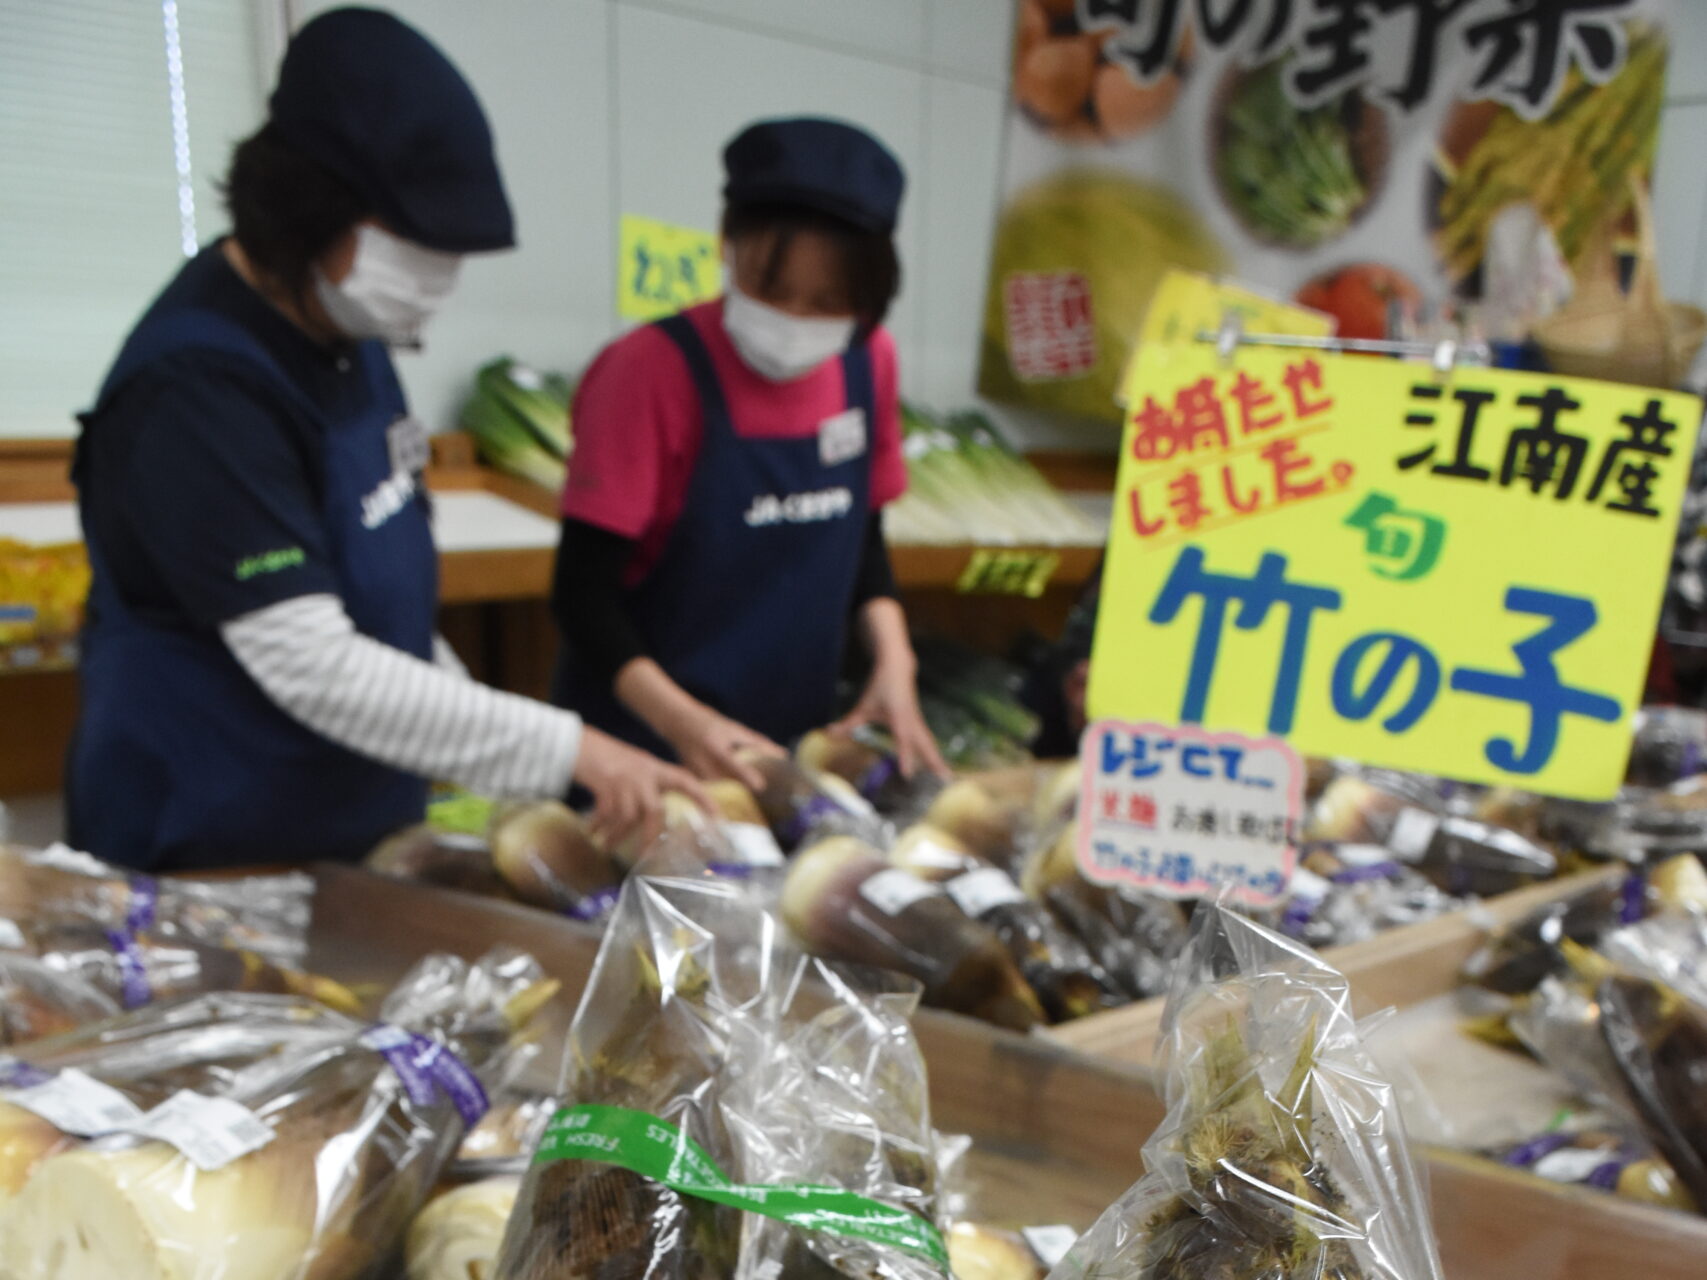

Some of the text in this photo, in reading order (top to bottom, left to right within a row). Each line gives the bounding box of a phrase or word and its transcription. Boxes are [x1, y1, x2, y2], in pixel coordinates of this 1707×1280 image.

[1396, 381, 1679, 519] 江南産
[1343, 491, 1447, 582] 旬
[1147, 545, 1623, 776] 竹の子
